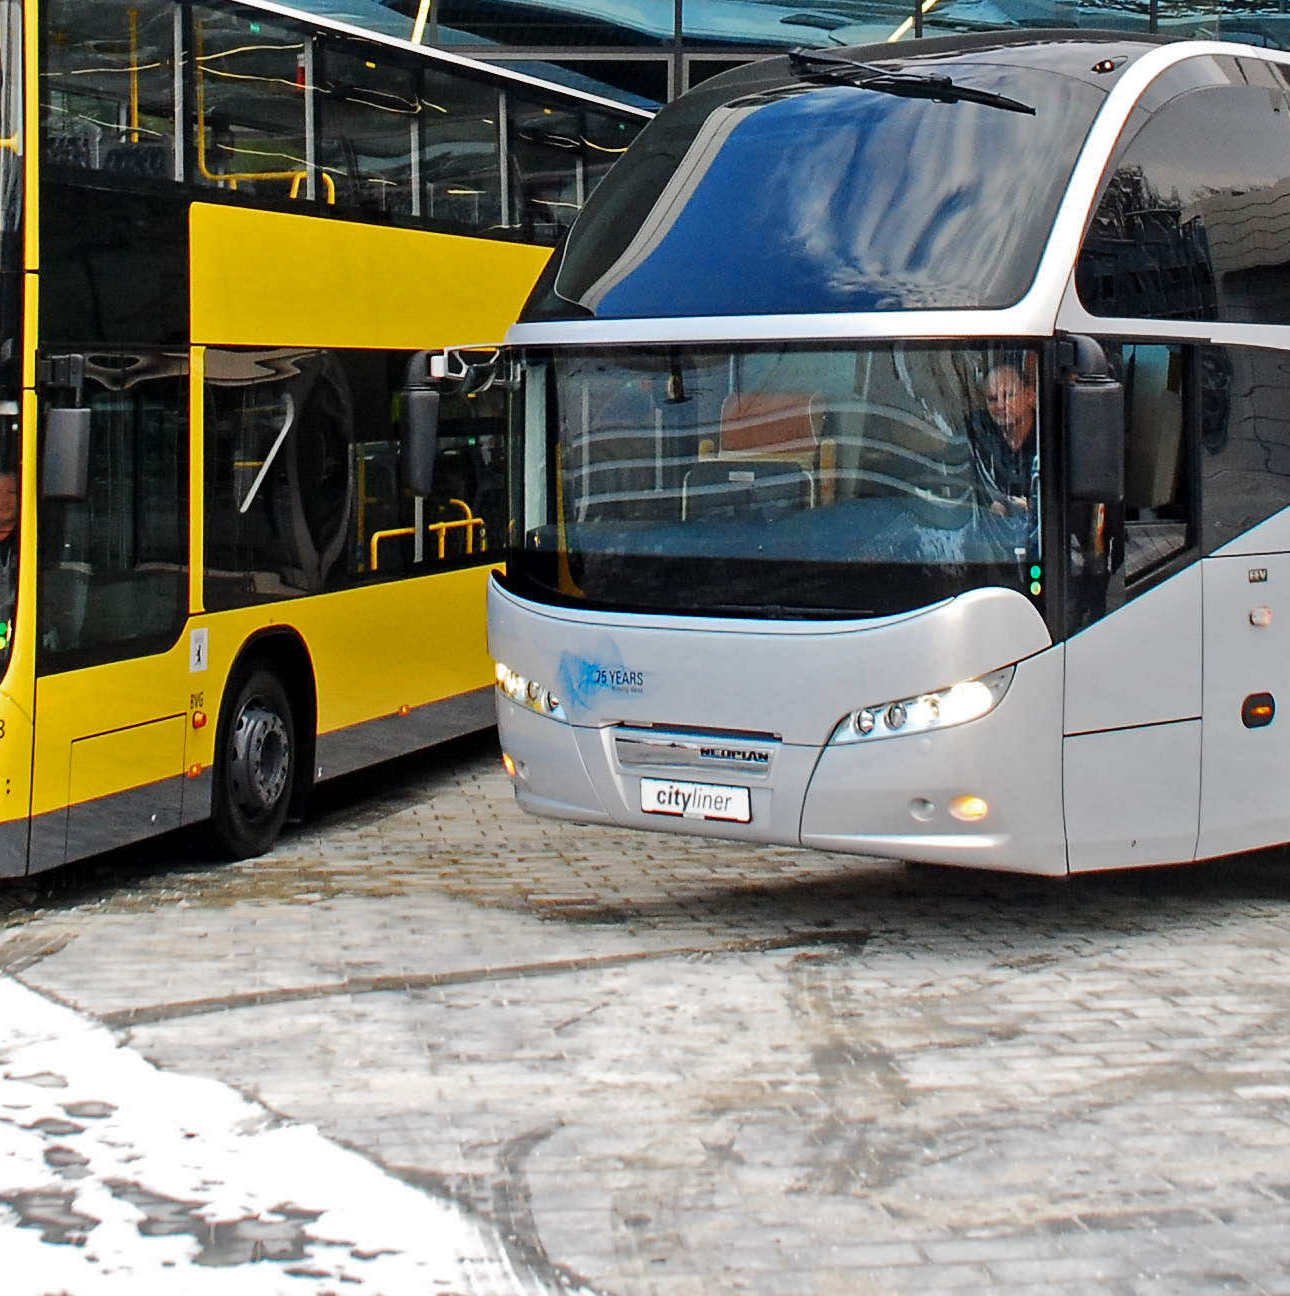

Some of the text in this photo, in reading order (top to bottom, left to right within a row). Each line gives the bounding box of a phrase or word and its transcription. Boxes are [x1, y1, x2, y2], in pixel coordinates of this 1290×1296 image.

[596, 670, 643, 686] 75 YEARS
[656, 785, 732, 812] cityliner
